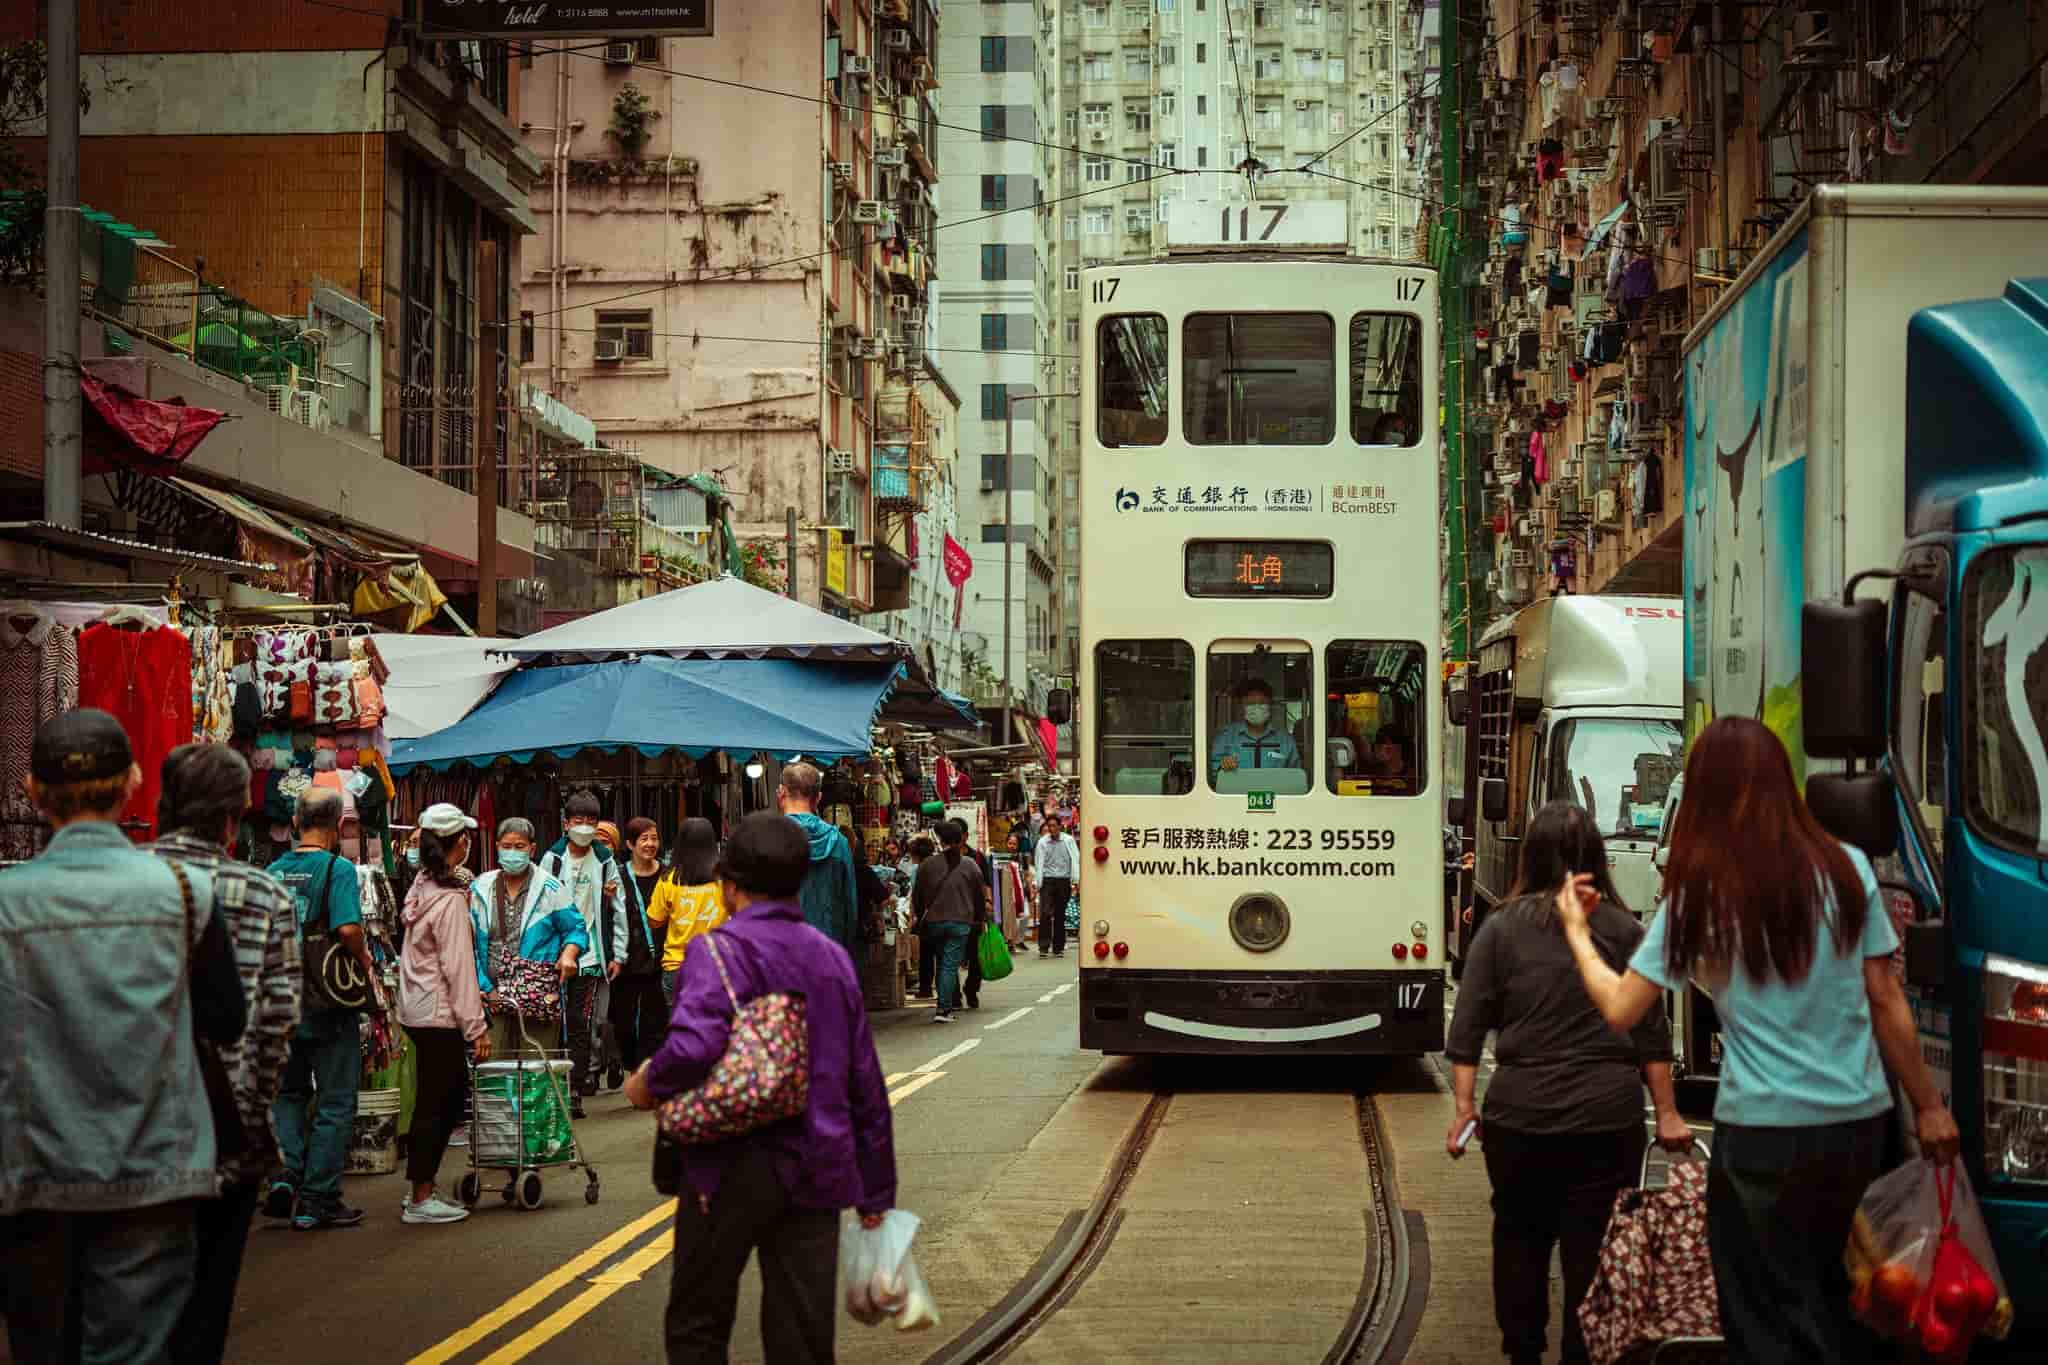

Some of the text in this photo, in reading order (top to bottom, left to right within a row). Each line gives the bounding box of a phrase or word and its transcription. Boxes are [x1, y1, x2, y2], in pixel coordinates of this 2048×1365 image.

[503, 3, 547, 25] hotel
[1221, 205, 1289, 241] 117
[1093, 278, 1120, 303] 117
[1397, 277, 1425, 301] 117
[1152, 486, 1249, 504] 交通銀行
[1332, 502, 1397, 514] BComBEST
[1236, 554, 1282, 584] 北角
[1267, 829, 1312, 850] 223
[1321, 829, 1395, 850] 95559
[1120, 857, 1395, 877] www.hk.bankcomm.com
[1397, 983, 1426, 1009] 117
